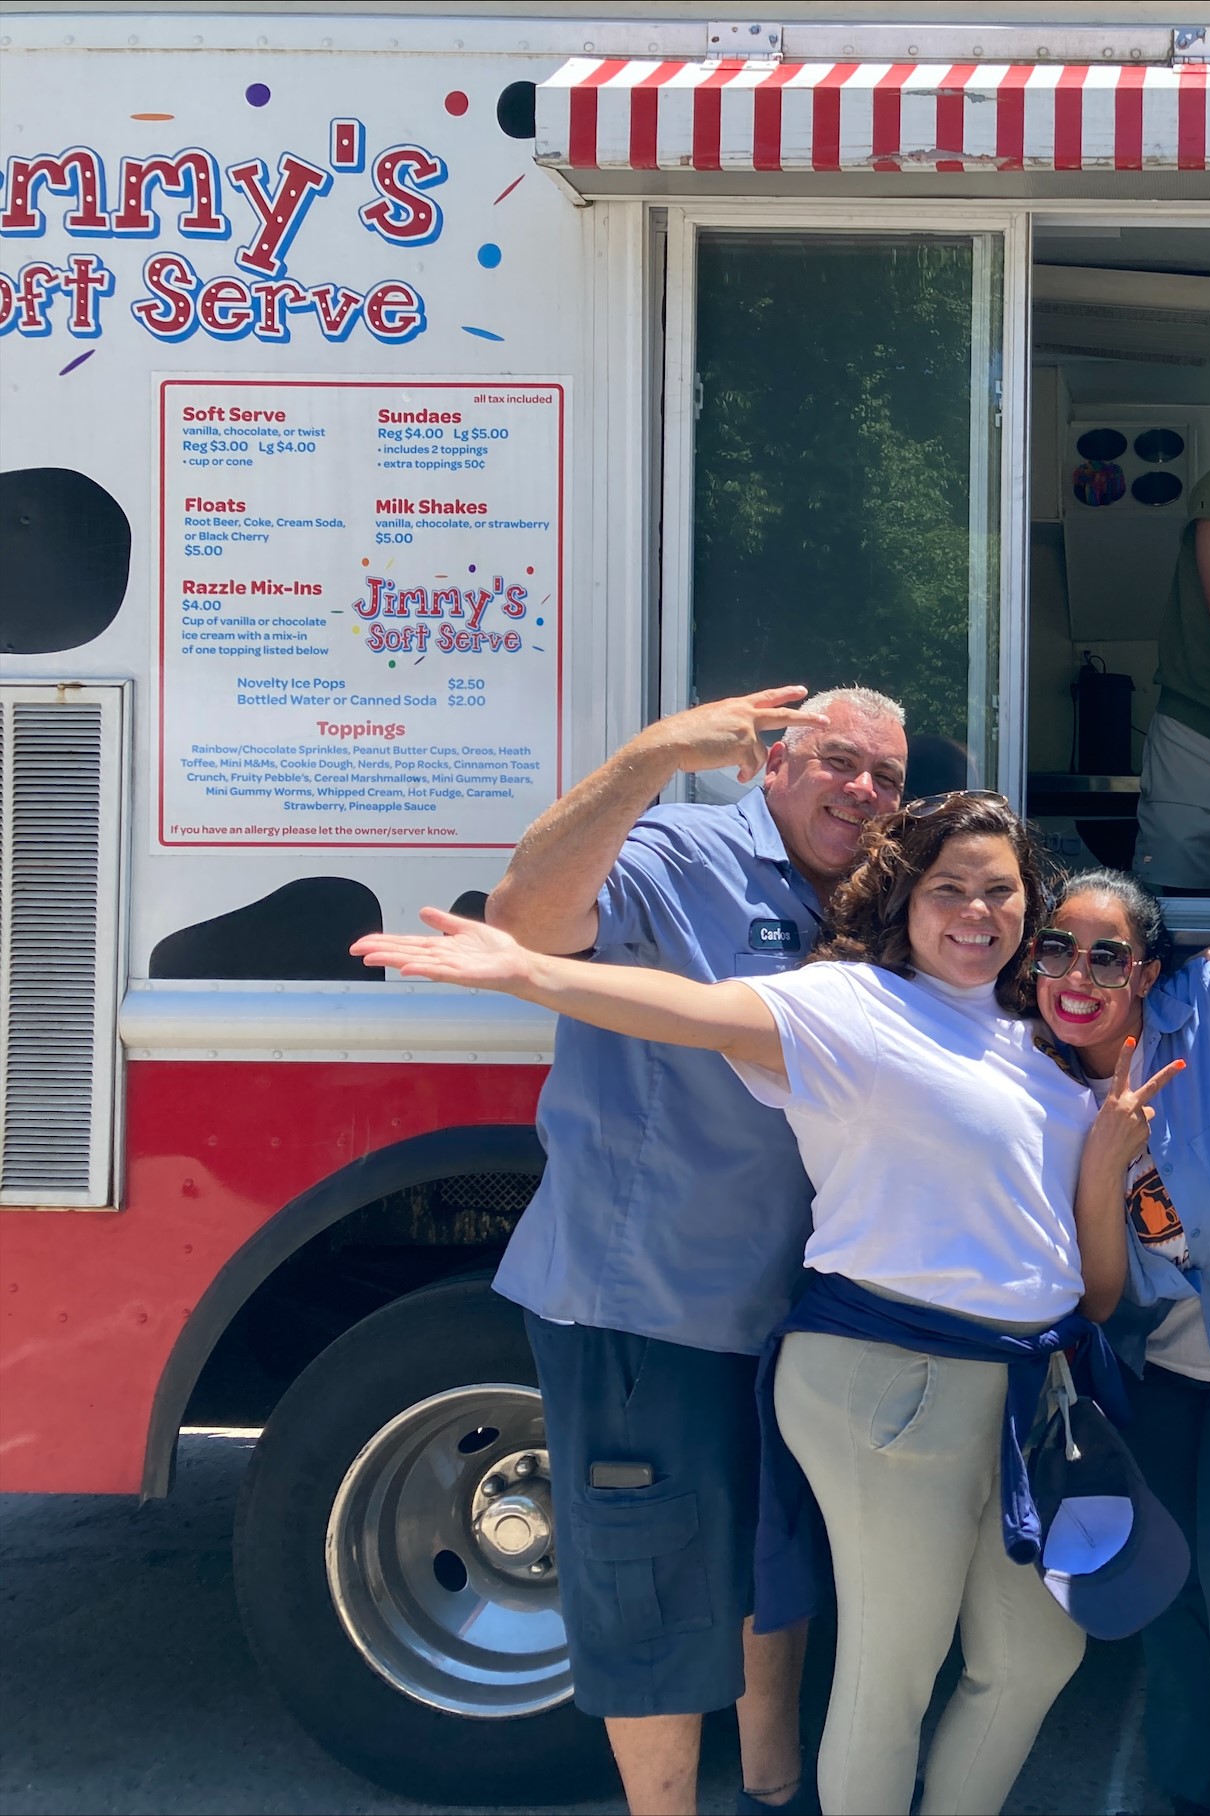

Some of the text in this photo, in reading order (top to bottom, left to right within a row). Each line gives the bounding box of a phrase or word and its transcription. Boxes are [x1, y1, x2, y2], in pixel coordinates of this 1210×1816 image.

[0, 118, 448, 279] mmy's
[132, 252, 427, 344] Serve
[474, 395, 552, 403] all tax included
[183, 406, 286, 422] Soft Serve
[378, 409, 461, 423] Sundaes
[183, 427, 221, 436] vanilla,
[224, 427, 281, 437] chocolate,
[298, 428, 325, 436] twist
[378, 427, 443, 441] Reg $4.00
[454, 428, 508, 441] Lg $5.00
[183, 440, 248, 454] Reg $3.00
[259, 441, 315, 454] Lg $4.00
[384, 445, 429, 453] includes
[441, 446, 488, 456] toppings
[189, 457, 209, 467] cup
[226, 458, 253, 466] cone
[384, 460, 485, 470] extra toppings 50¢
[185, 497, 246, 512] Floats
[376, 498, 487, 514] Milk Shakes
[185, 517, 345, 528] Root Beer, Coke, Cream Soda,
[376, 519, 413, 529] vanilla,
[416, 519, 472, 529] chocolate,
[488, 519, 549, 530] strawberry
[199, 532, 228, 541] Black
[231, 532, 269, 543] Cherry
[376, 532, 413, 544] $5.00
[185, 545, 223, 556] $5.00
[183, 580, 322, 595] Razzle Mix-Ins
[182, 599, 221, 611] $4.00
[352, 576, 528, 631] Jimmy's
[182, 617, 204, 627] Cup
[207, 616, 218, 625] of
[220, 617, 255, 626] vanilla
[272, 617, 326, 626] chocolate
[182, 631, 198, 639] ice
[238, 631, 261, 640] with
[273, 632, 307, 640] mix-in
[365, 622, 521, 653] Soft Serve
[182, 645, 194, 654] of
[219, 646, 261, 656] topping
[263, 646, 293, 655] listed
[296, 646, 329, 655] below
[237, 677, 345, 691] Novelty Ice Pops
[448, 678, 485, 690] $2.50
[237, 694, 437, 706] Bottled Water or Canned Soda
[448, 695, 486, 706] $2.00
[316, 720, 406, 740] Toppings
[192, 744, 531, 757] Rainbow/Chocolate Sprinkles, Peanut Butter Cups, Oreos, Heath
[181, 759, 540, 770] Toffee, Mini M&Ms, Cookie Dough, Nerds, Pop Rocks, Cinnamon Toast
[187, 773, 228, 783] Crunch,
[231, 773, 262, 784] Fruity
[315, 774, 348, 782] Cereal
[351, 774, 429, 784] Marshmallows,
[432, 774, 453, 782] Mini
[456, 775, 497, 785] Gummy
[500, 775, 533, 784] Bears,
[206, 787, 514, 799] Mini Gummy Worms, Whipped Cream, Hot Fudge, Caramel,
[284, 802, 436, 812] Strawberry, Pineapple Sauce
[171, 825, 180, 833] If
[182, 827, 199, 836] you
[202, 826, 227, 834] have
[244, 826, 281, 836] allergy
[283, 826, 316, 837] please
[319, 826, 332, 834] let
[335, 826, 352, 834] the
[355, 827, 425, 837] owner/server
[427, 827, 458, 835] know.
[760, 928, 790, 940] Carlos
